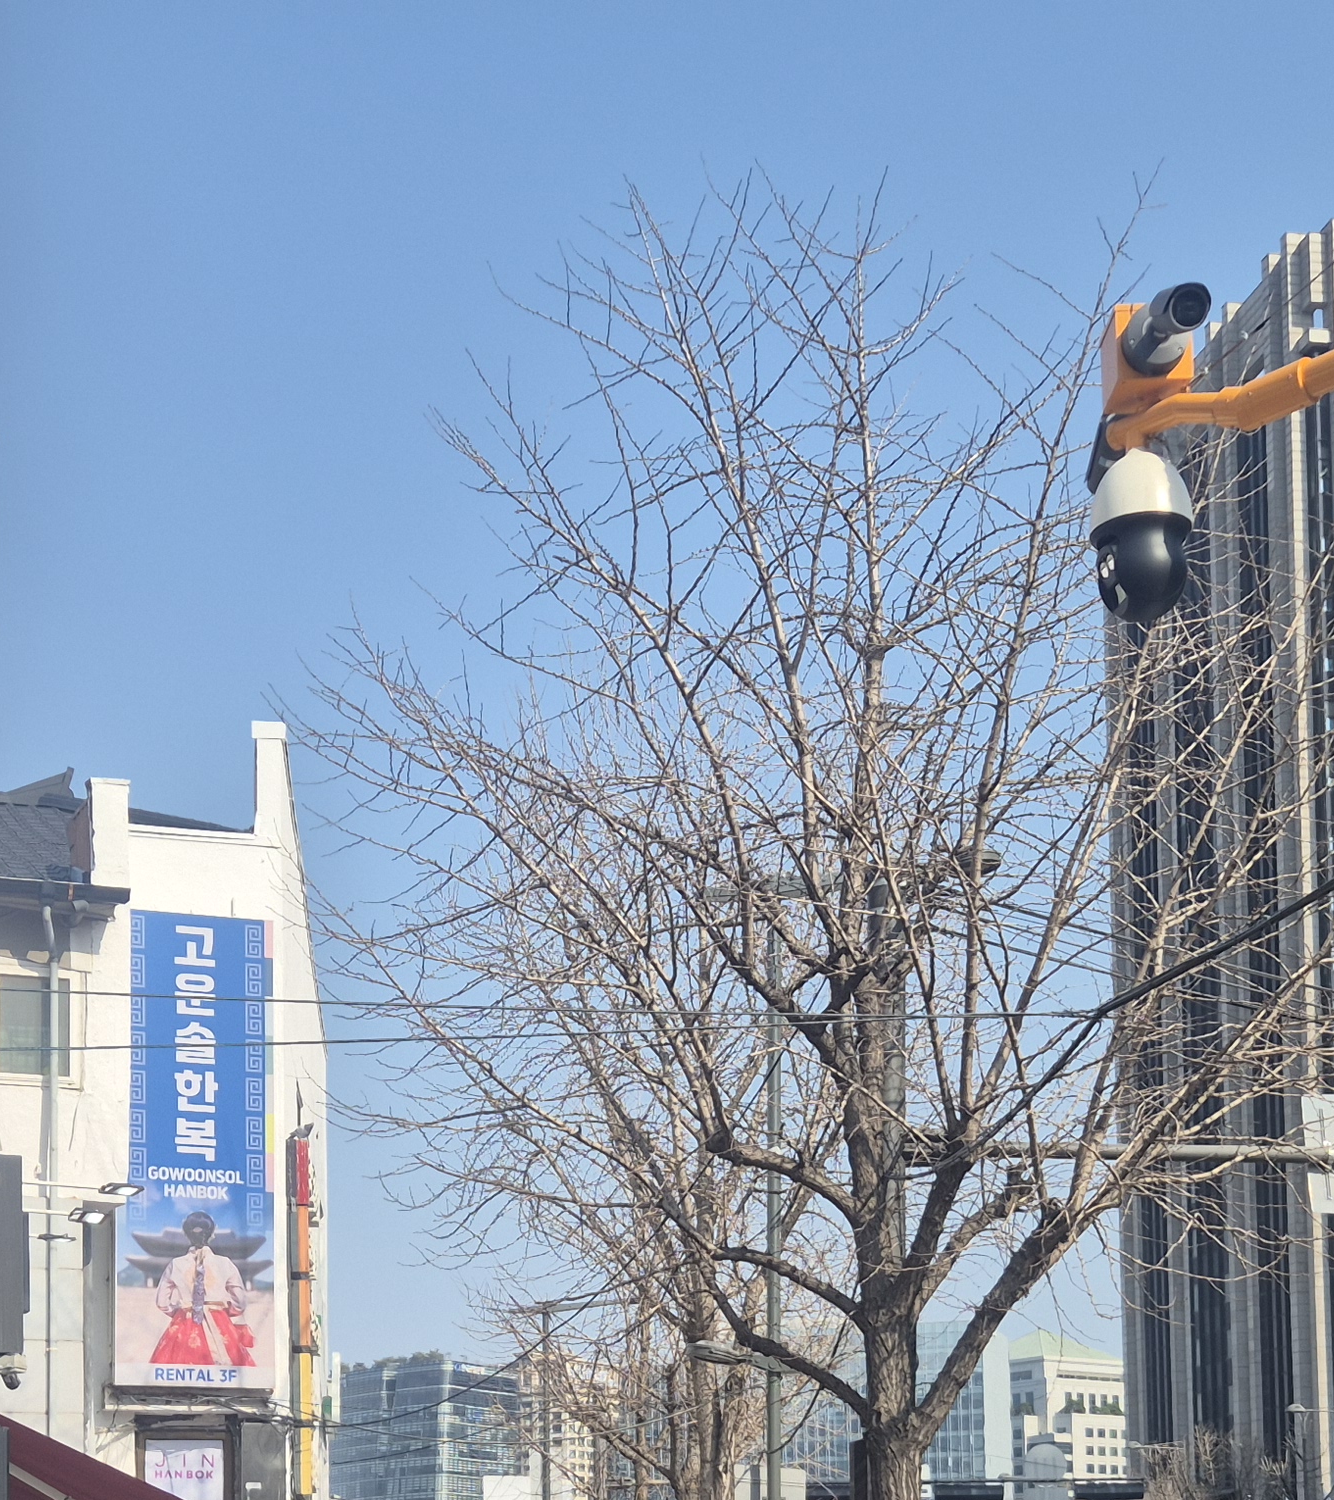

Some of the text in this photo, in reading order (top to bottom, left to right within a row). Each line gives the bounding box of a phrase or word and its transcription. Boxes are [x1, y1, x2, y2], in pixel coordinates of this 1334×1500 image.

[173, 924, 219, 1162] 고운솔한복
[147, 1165, 245, 1185] GOWOONSOL
[163, 1183, 229, 1201] HANBOK
[153, 1366, 238, 1383] RENTAL 3F
[153, 1469, 214, 1479] HANBOK
